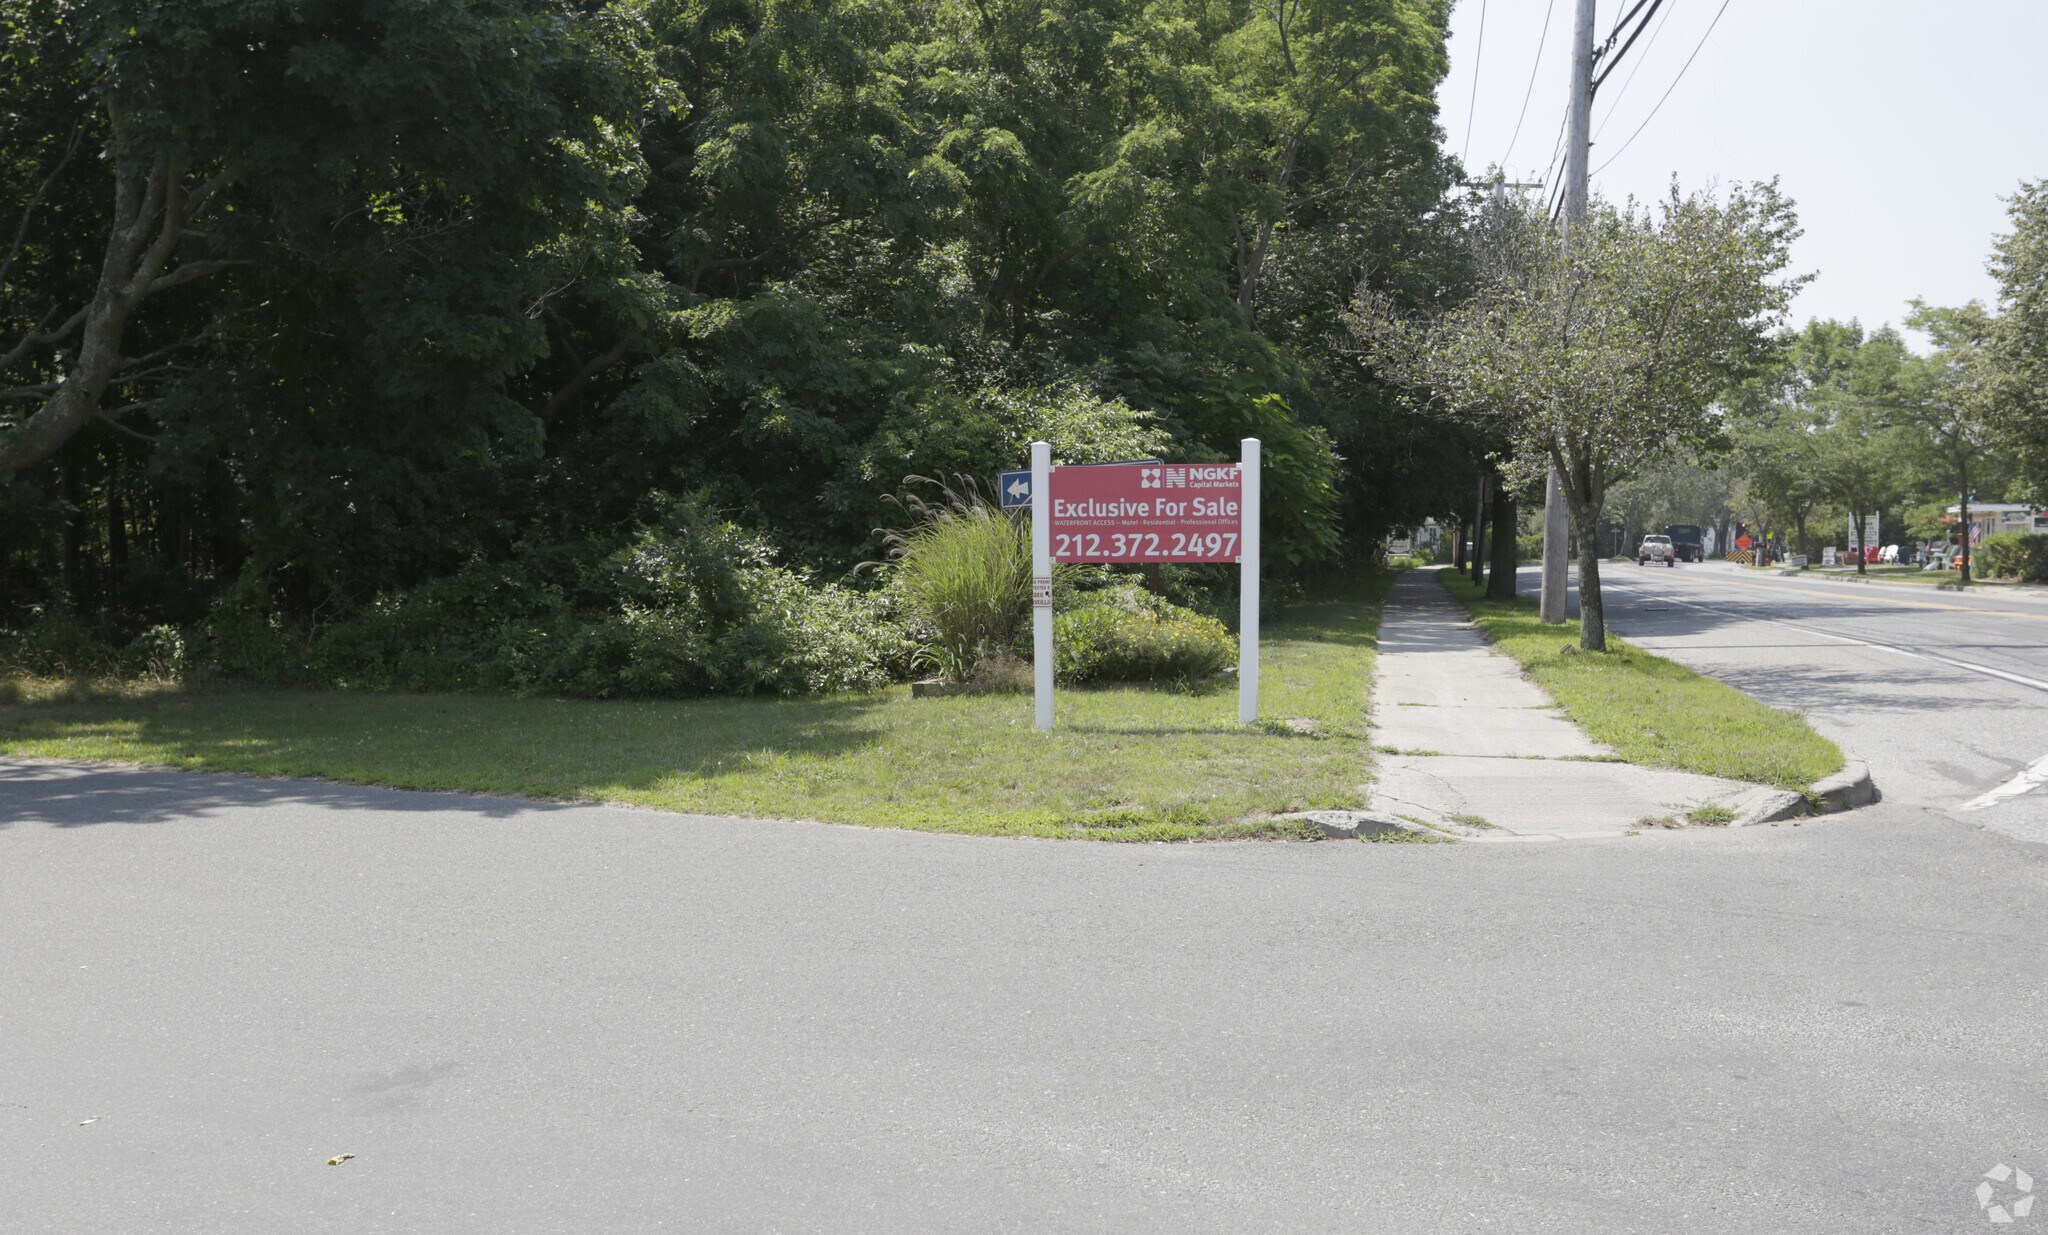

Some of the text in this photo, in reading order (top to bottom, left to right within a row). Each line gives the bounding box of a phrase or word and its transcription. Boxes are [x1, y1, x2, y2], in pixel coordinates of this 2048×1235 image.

[1190, 467, 1239, 480] NGKF
[1189, 480, 1239, 489] Capital Markets
[1054, 496, 1238, 518] Exclusive For Sale
[1218, 518, 1239, 526] Offices
[1055, 532, 1239, 558] 212.372.2497
